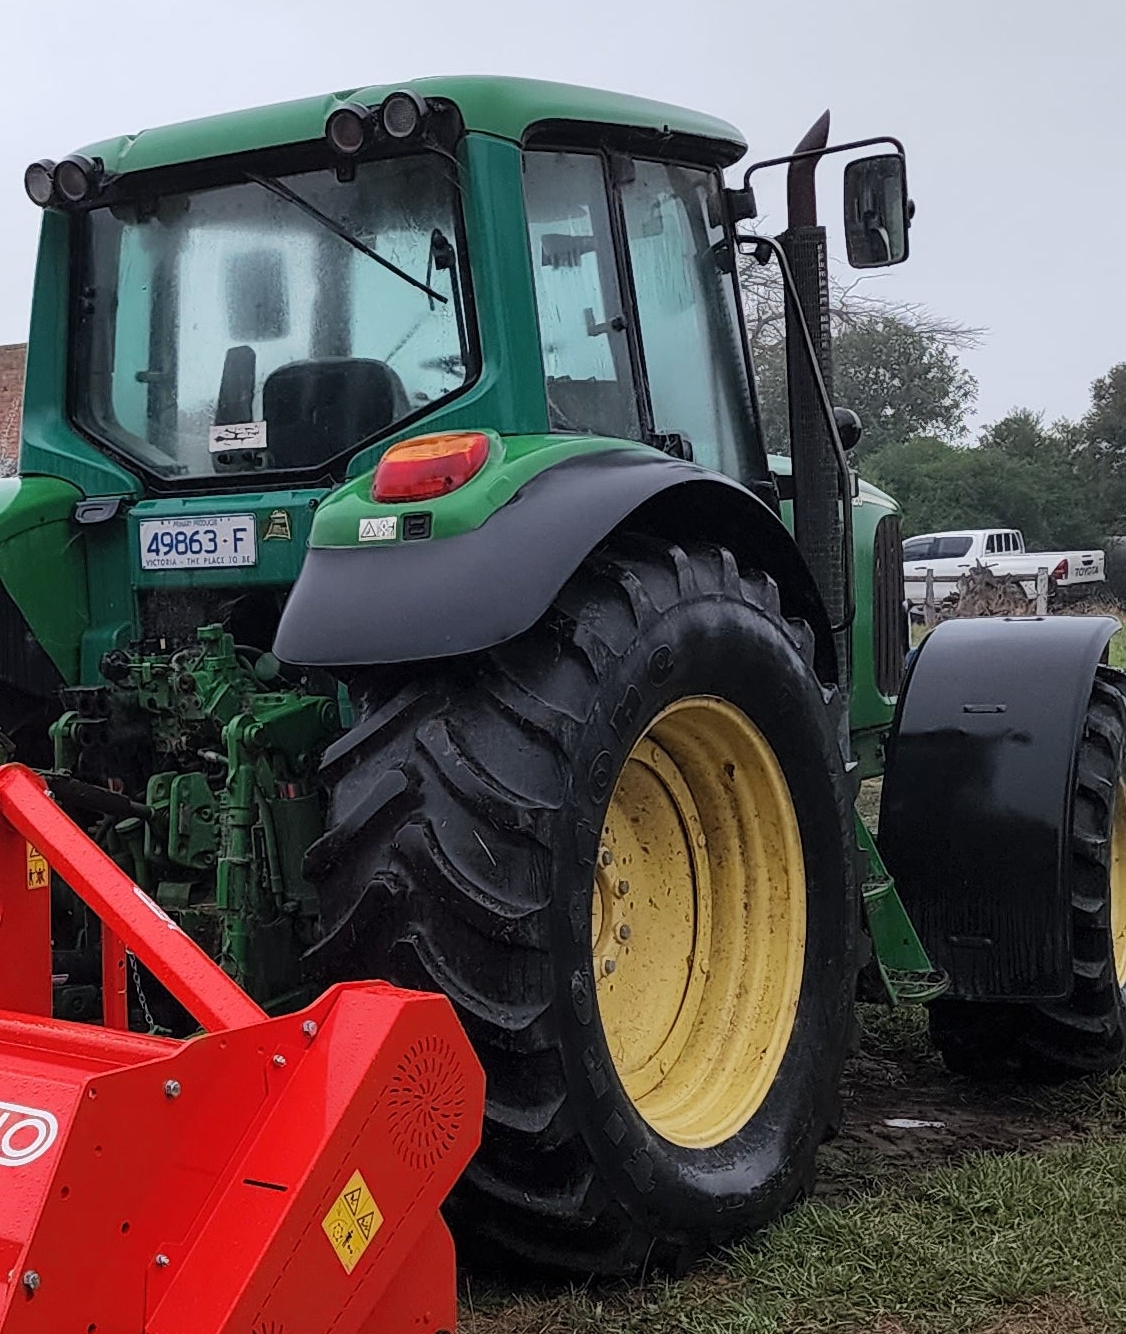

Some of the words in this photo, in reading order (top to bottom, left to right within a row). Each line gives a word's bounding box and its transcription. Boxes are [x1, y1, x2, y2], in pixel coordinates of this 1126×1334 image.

[147, 529, 218, 557] 49863
[145, 558, 176, 567] VICTORIA
[187, 557, 200, 565] THE
[203, 556, 225, 565] PLACE
[228, 555, 238, 564] TO
[241, 555, 251, 563] BE
[1075, 566, 1098, 577] TOYOTA
